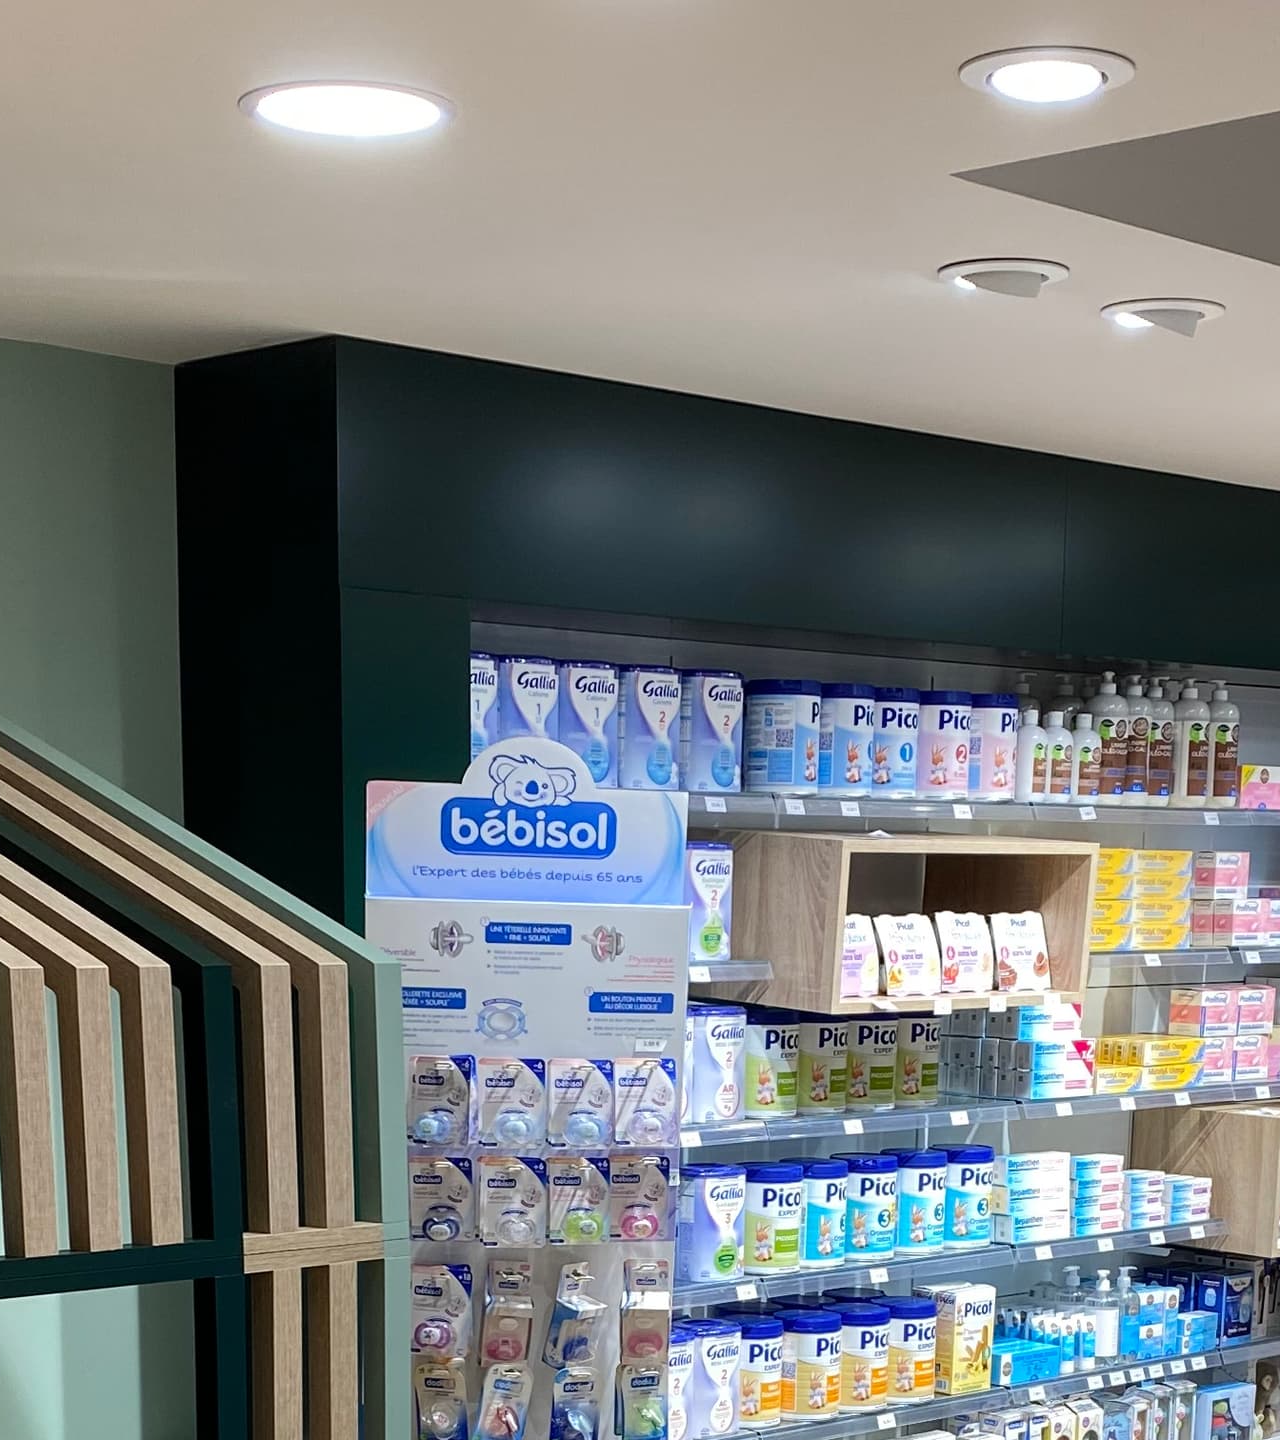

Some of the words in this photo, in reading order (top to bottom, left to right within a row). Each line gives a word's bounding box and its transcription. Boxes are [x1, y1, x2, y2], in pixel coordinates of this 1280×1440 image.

[518, 671, 556, 693] Gallia
[575, 674, 615, 697] Gallia
[643, 680, 678, 701] Gallia
[709, 683, 742, 704] Gallia
[451, 807, 607, 850] bébisol
[471, 867, 496, 878] des
[500, 867, 542, 880] bébés
[546, 869, 593, 884] depuis
[596, 871, 612, 882] 65
[616, 873, 642, 883] ans
[696, 860, 729, 877] Gallia
[711, 1025, 744, 1041] Gallia
[710, 1186, 743, 1201] Gallia
[964, 1302, 992, 1317] Picot
[706, 1344, 739, 1360] Gallia
